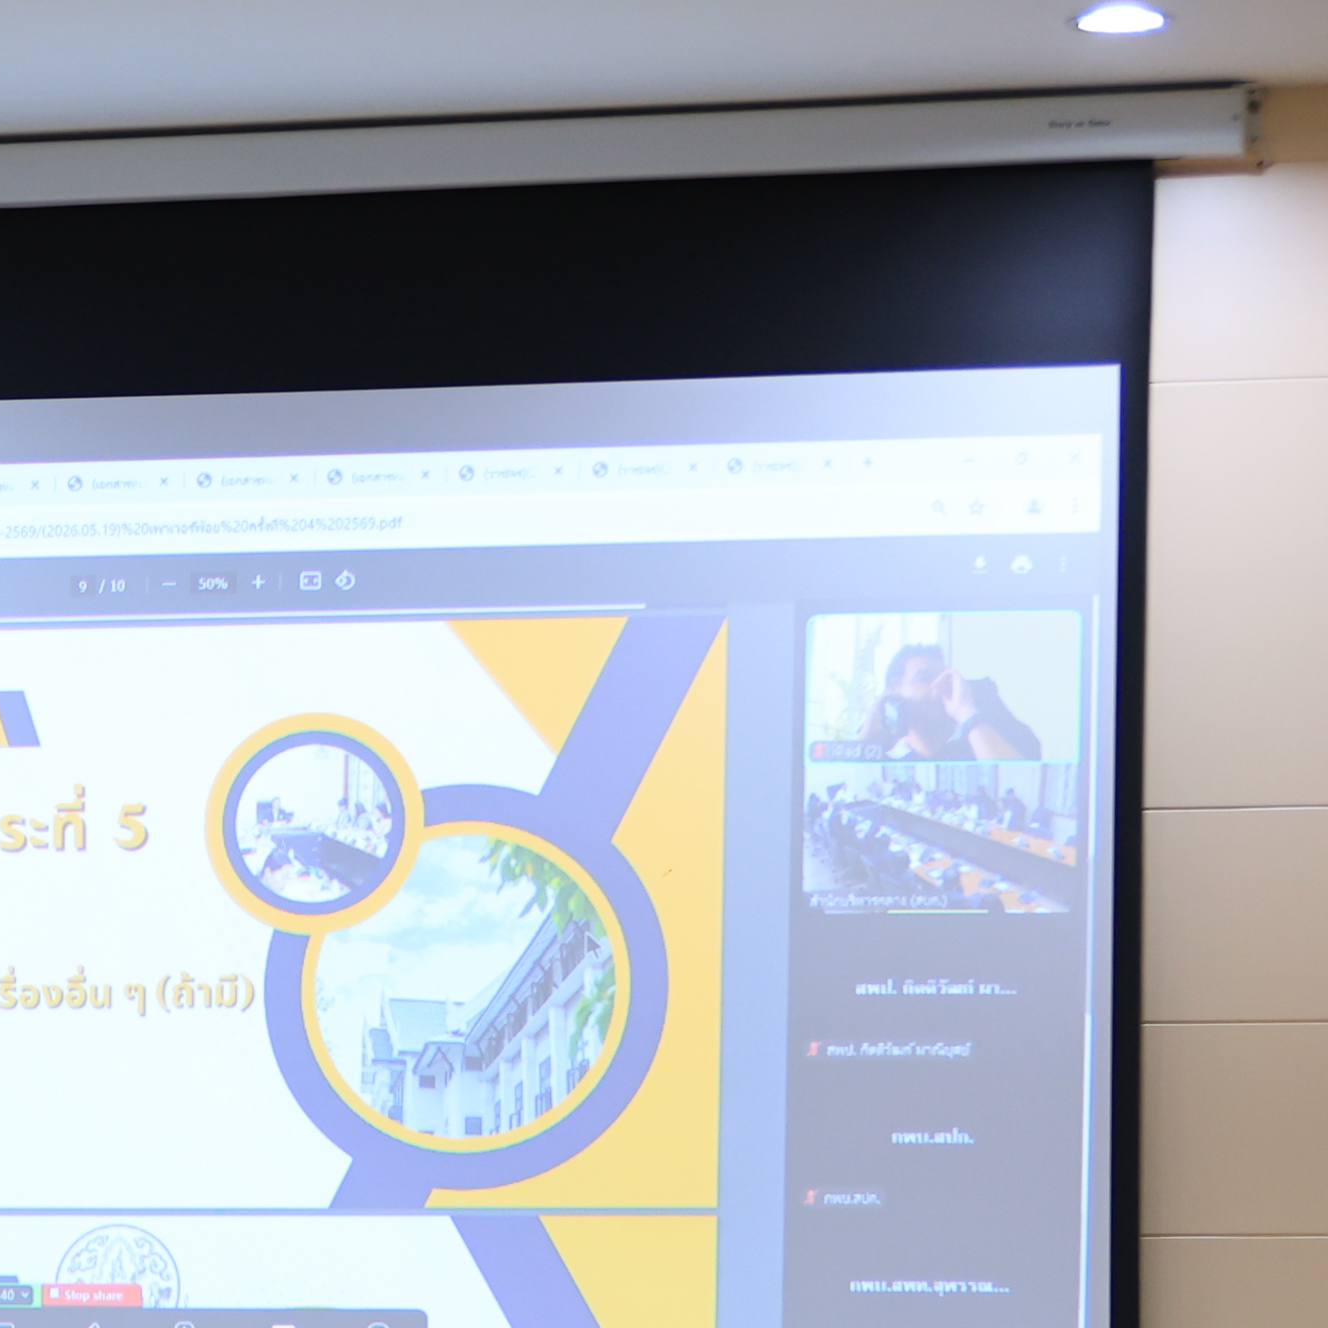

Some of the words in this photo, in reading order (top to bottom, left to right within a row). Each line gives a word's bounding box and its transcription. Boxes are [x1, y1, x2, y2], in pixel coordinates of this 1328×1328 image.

[77, 579, 88, 593] 9
[110, 578, 126, 593] 10
[197, 577, 229, 591] 50%
[114, 803, 149, 852] 5
[124, 979, 148, 1016] ๆ
[156, 971, 256, 1013] (ถ้ามี)
[64, 1288, 87, 1304] Stop
[90, 1288, 124, 1302] share
